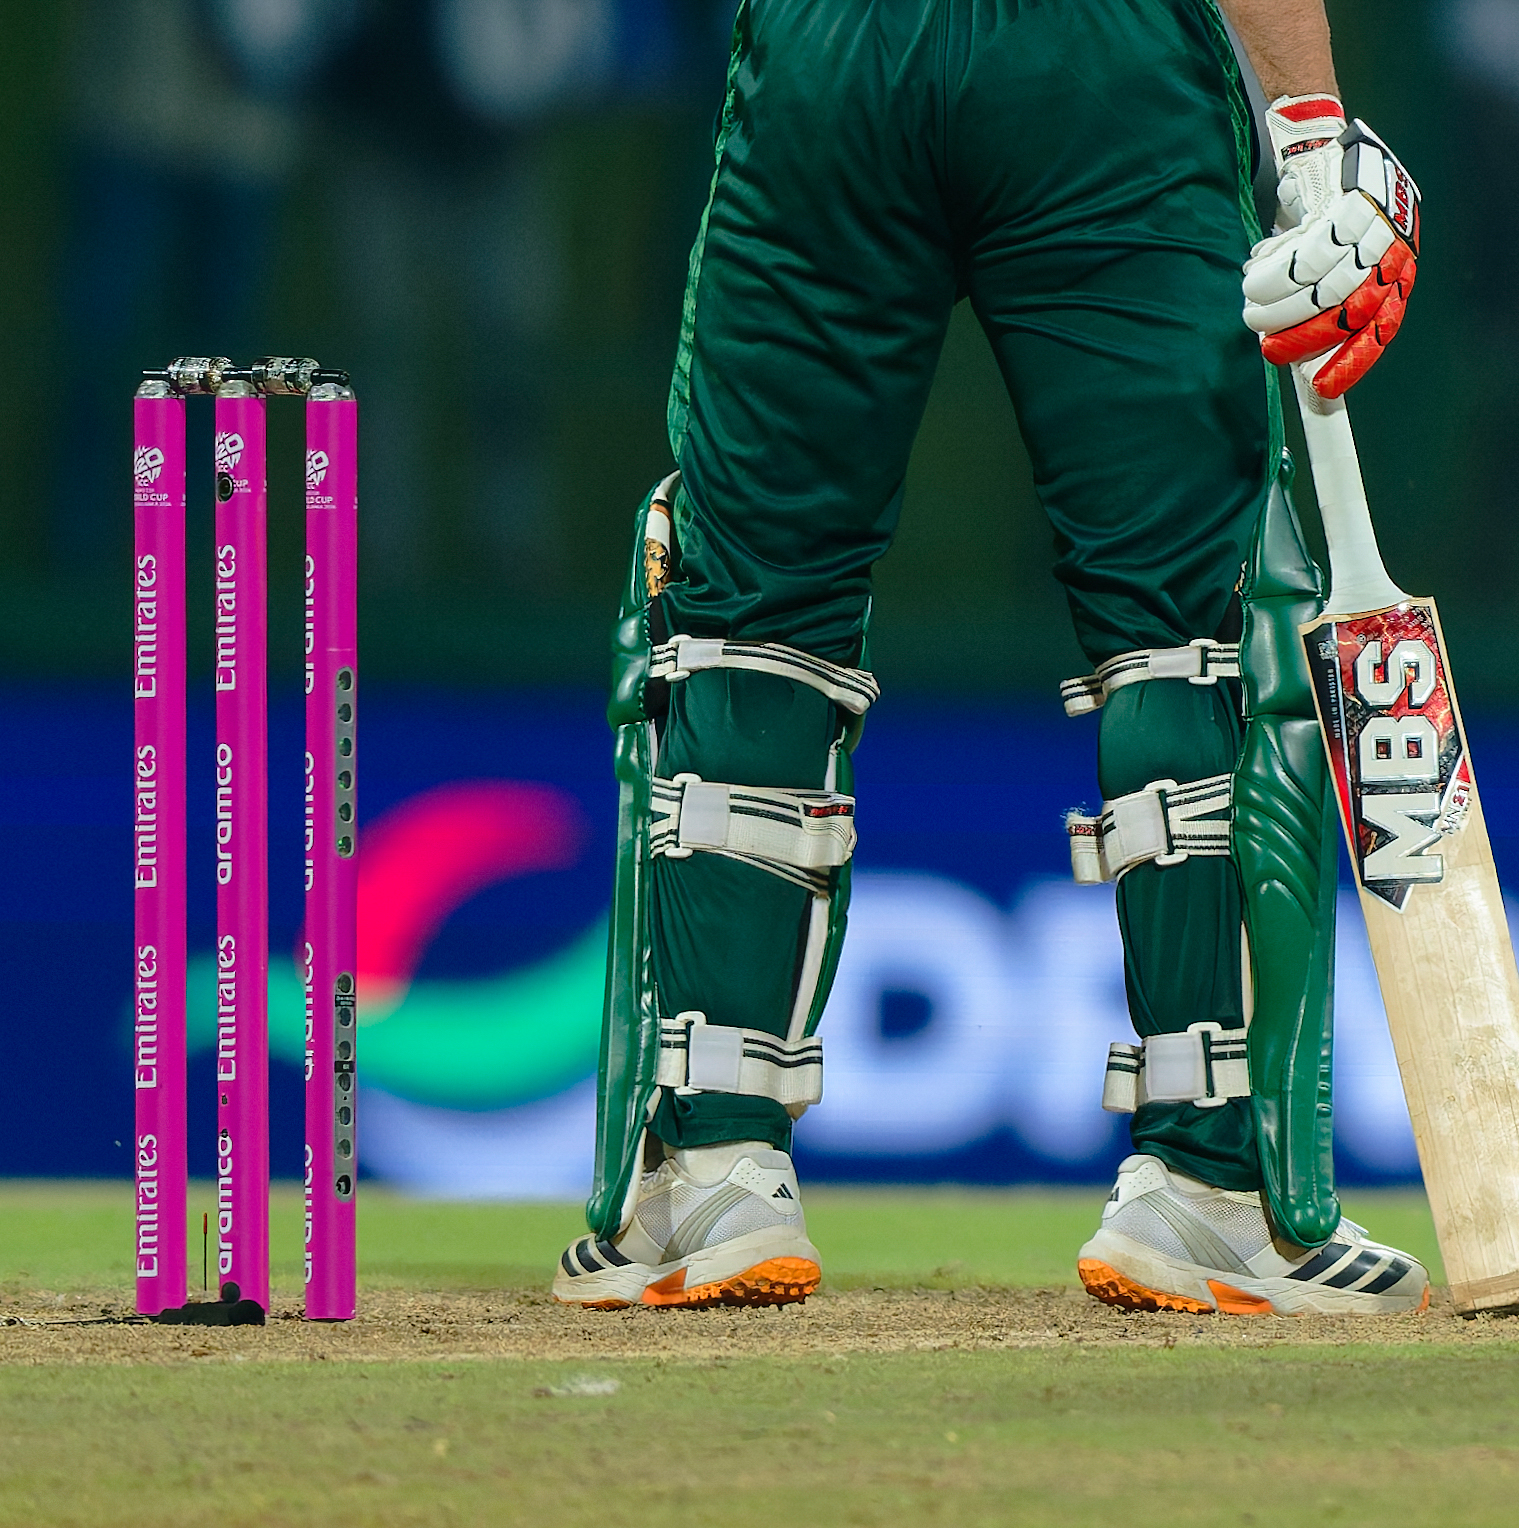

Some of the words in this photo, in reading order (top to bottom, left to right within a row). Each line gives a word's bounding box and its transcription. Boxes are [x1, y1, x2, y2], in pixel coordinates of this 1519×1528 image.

[134, 553, 157, 700] Emirates
[215, 543, 237, 693] Emirates
[134, 743, 157, 890] Emirates
[216, 743, 234, 885] aramco
[1353, 639, 1444, 884] MBS
[135, 945, 158, 1091] Emirates
[216, 934, 237, 1083] Emirates
[136, 1134, 158, 1279] Emirates
[217, 1133, 234, 1276] aramco
